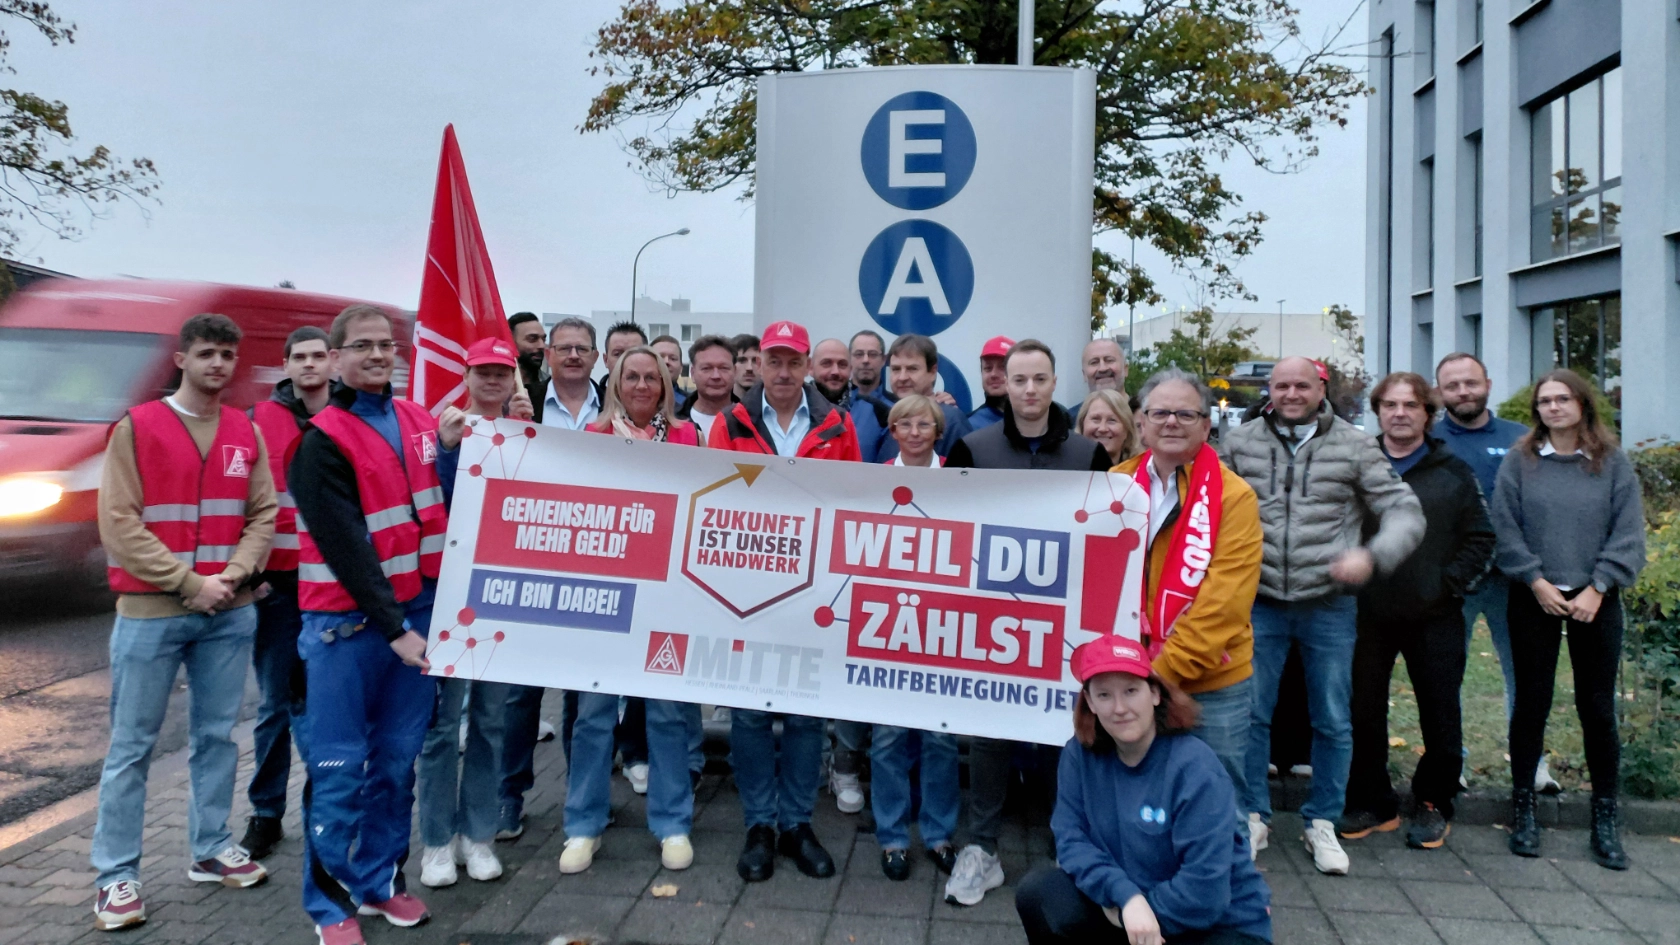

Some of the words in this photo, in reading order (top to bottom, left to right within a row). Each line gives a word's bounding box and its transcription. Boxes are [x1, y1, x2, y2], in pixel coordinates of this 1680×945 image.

[501, 496, 616, 531] GEMEINSAM
[619, 502, 656, 534] FÜR
[701, 507, 806, 537] ZUKUNFT
[515, 524, 572, 553] MEHR
[575, 530, 628, 559] GELD!
[699, 529, 732, 549] IST
[736, 533, 802, 556] UNSER
[844, 520, 962, 577] WEIL
[987, 535, 1060, 587] DU
[1180, 485, 1211, 588] SOLID
[697, 549, 801, 574] HANDWERK
[481, 578, 516, 606] ICH
[520, 581, 554, 610] BIN
[557, 585, 621, 616] DABEI!
[858, 592, 1054, 669] ZÄHLST
[845, 663, 1038, 707] TARIFBEWEGUNG
[1044, 687, 1080, 713] JET
